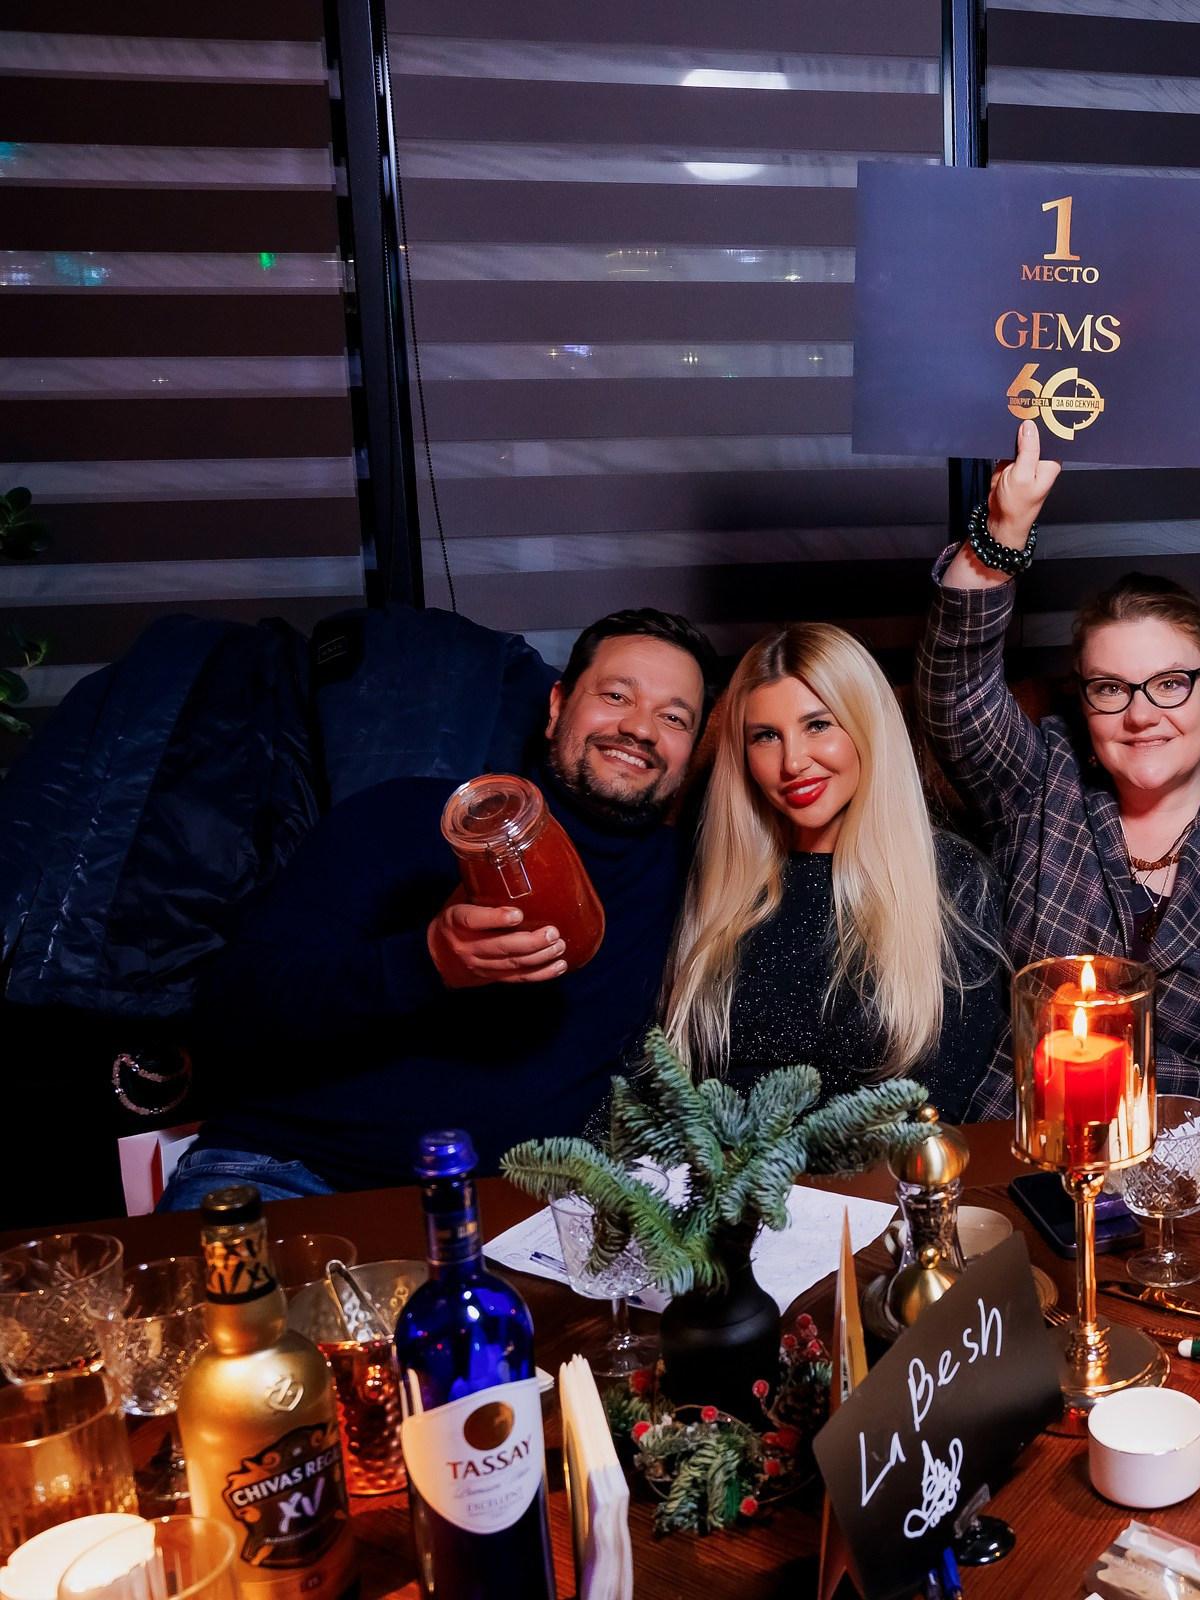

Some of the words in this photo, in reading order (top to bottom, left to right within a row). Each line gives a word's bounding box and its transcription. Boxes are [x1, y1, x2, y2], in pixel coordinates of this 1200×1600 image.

[1042, 196, 1080, 261] 1
[1020, 265, 1099, 284] МЕСТО
[994, 310, 1121, 353] GEMS
[1055, 399, 1065, 408] ЗА
[1065, 399, 1074, 408] 60
[1074, 399, 1100, 410] СЕКУНД
[907, 1297, 1003, 1433] Besh
[446, 1433, 532, 1480] TASSAY
[232, 1467, 304, 1507] CHIVAS
[277, 1475, 326, 1534] XV
